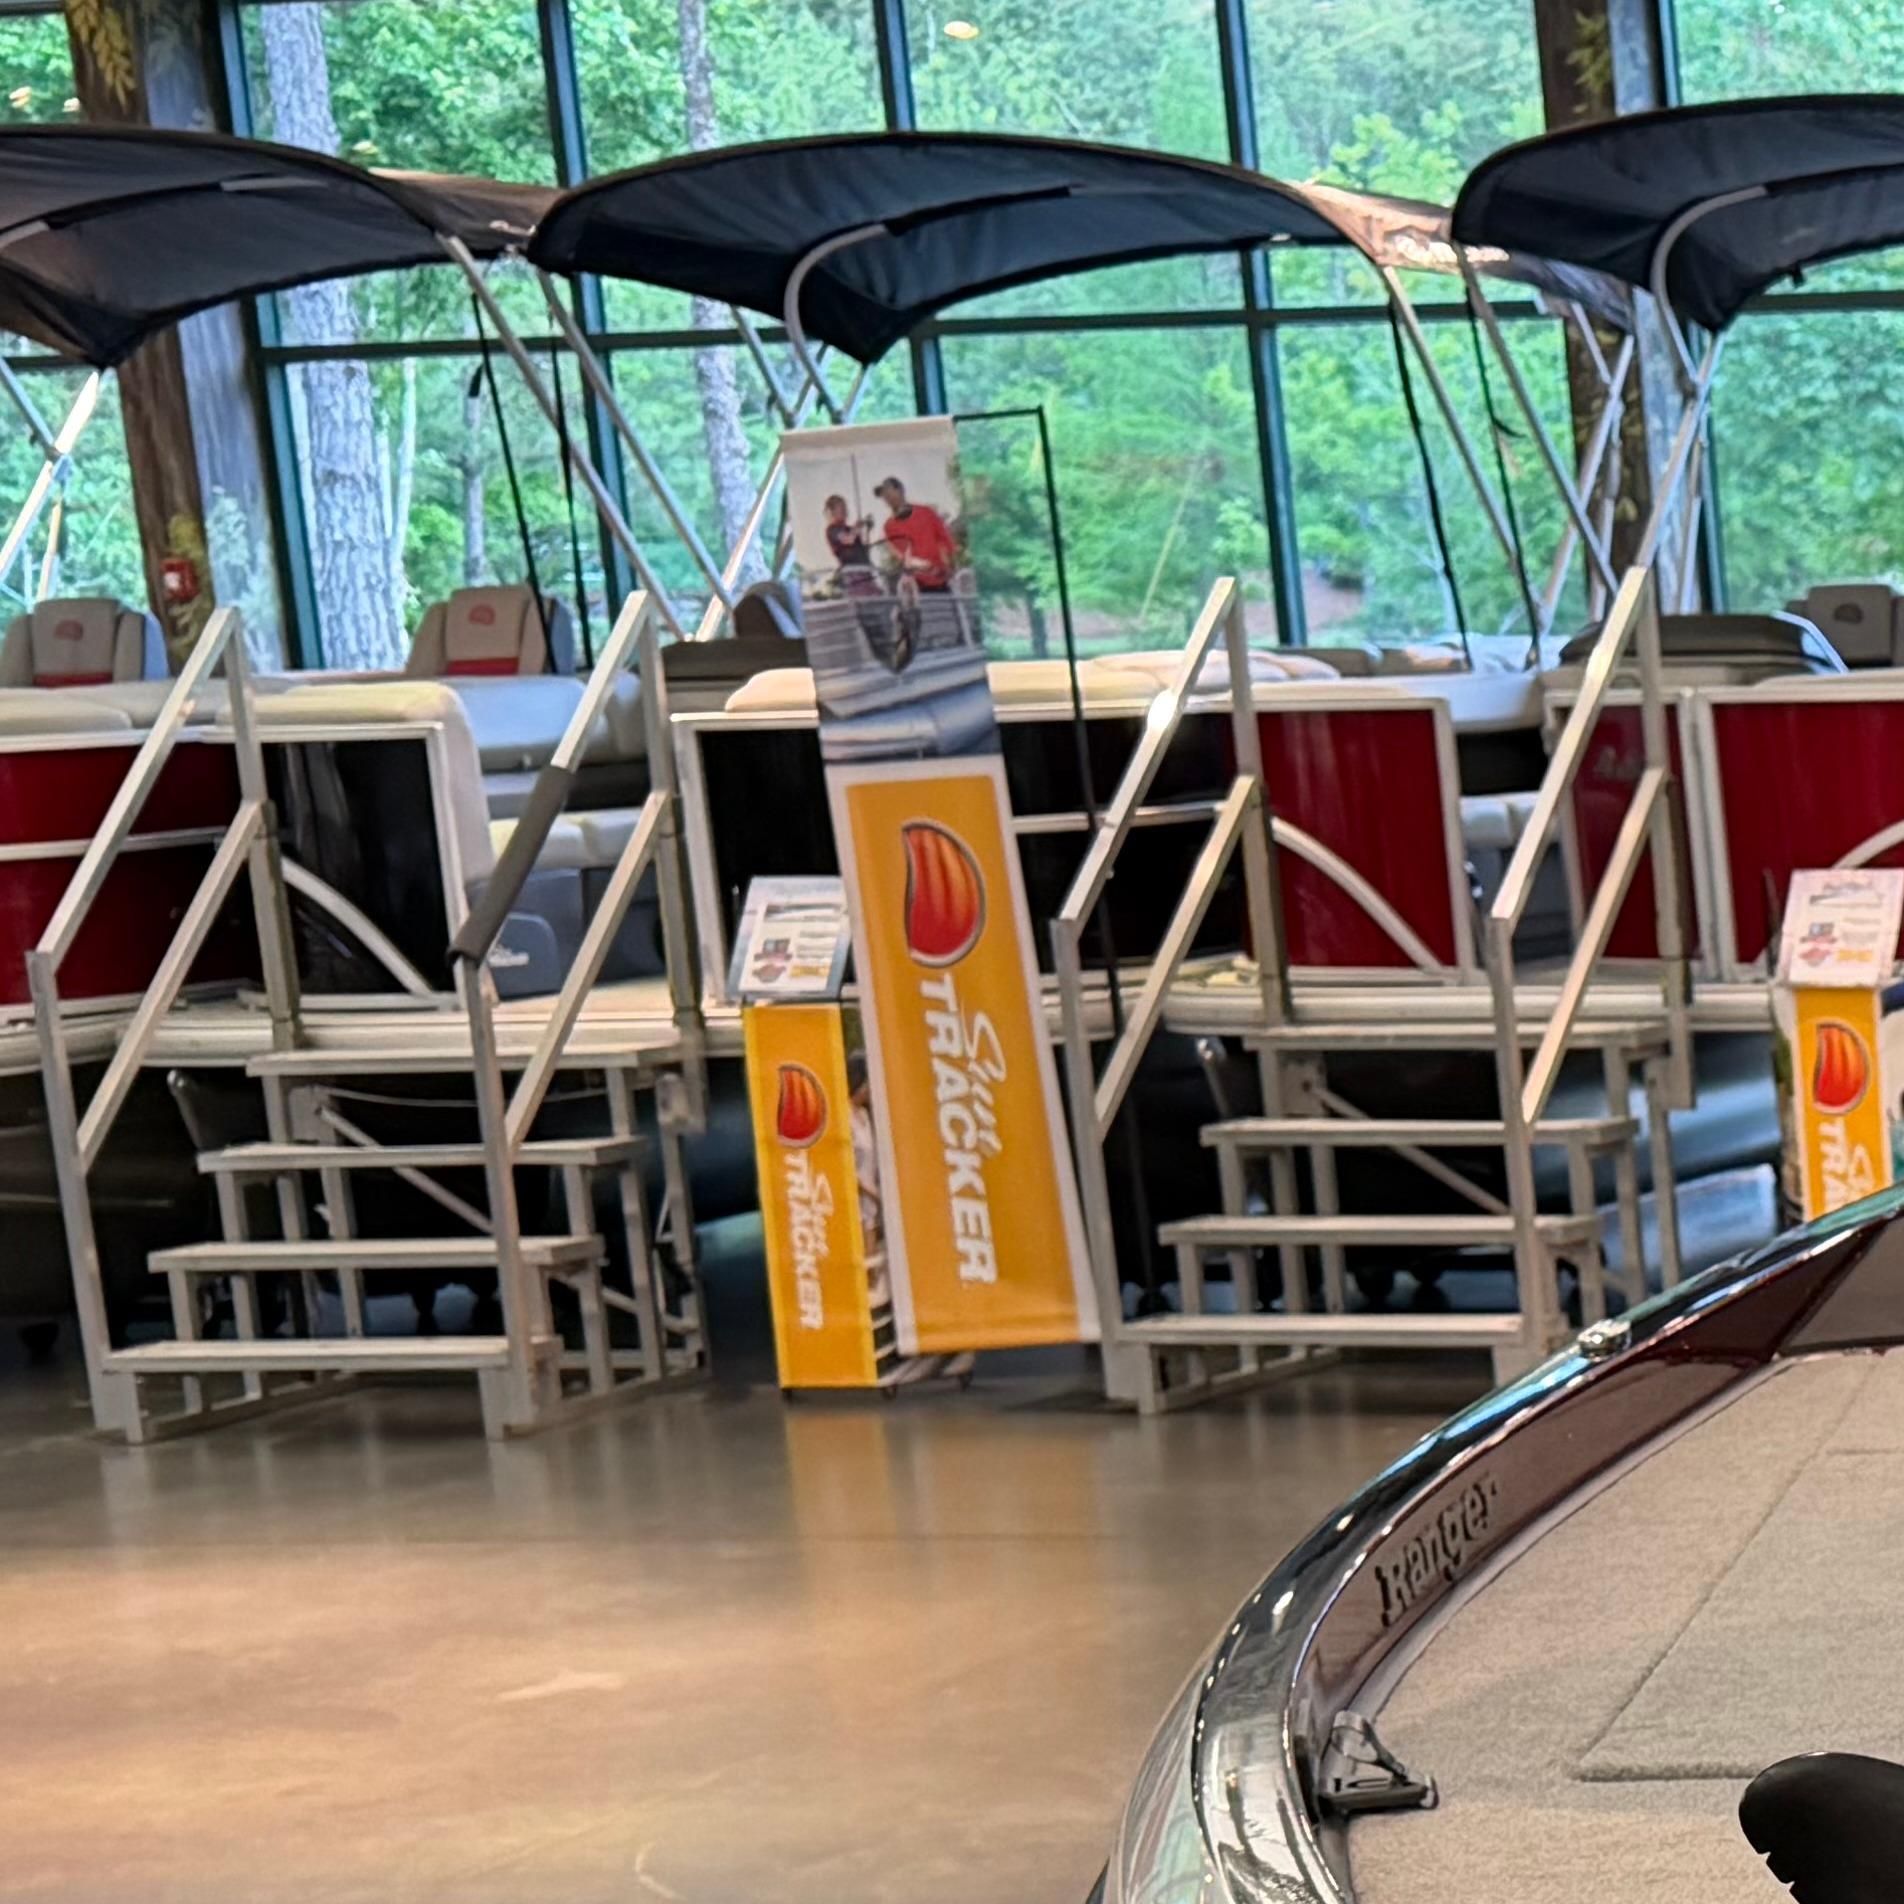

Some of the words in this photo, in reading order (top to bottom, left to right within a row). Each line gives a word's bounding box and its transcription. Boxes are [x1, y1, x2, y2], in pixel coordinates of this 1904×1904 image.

[920, 972, 998, 1285] TRACKER
[784, 1150, 824, 1330] TRACKER
[1373, 1472, 1504, 1628] Ranger
